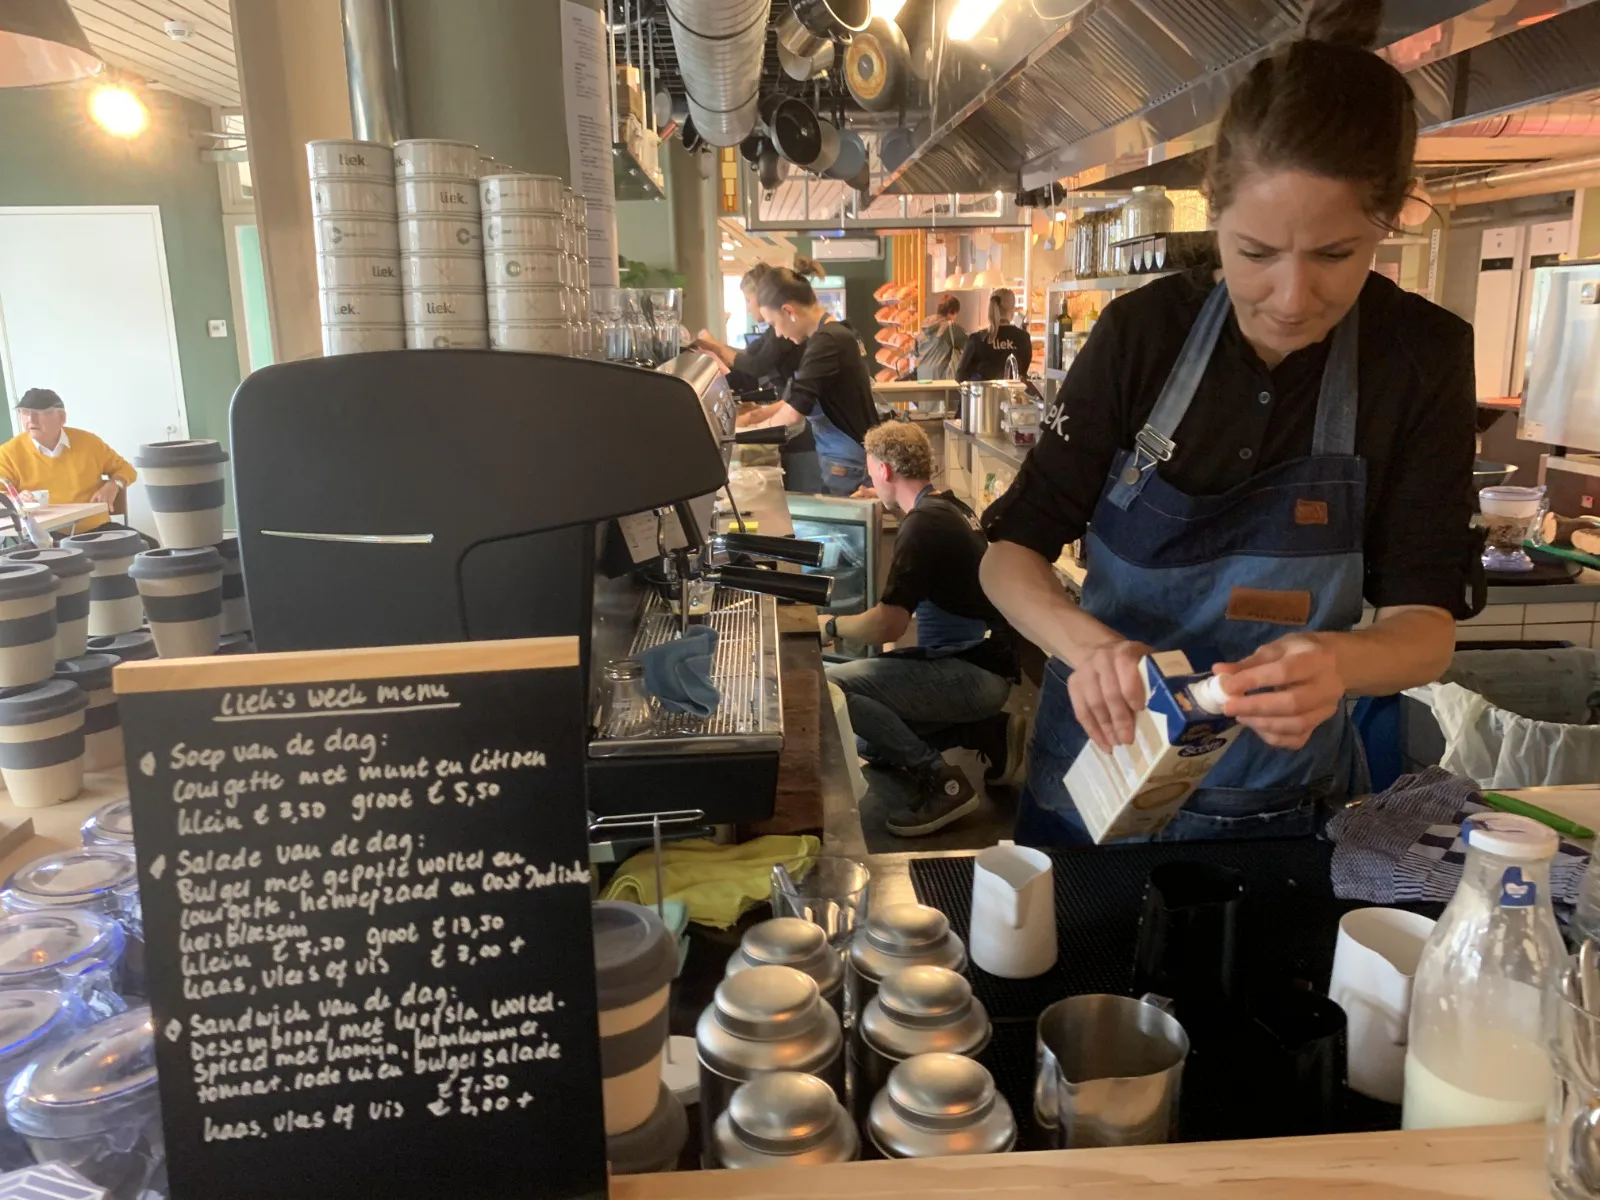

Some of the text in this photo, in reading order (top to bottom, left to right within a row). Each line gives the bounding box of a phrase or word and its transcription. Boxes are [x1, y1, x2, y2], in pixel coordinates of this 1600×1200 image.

[371, 265, 397, 278] liek.
[426, 302, 456, 314] liek.
[307, 683, 368, 708] week
[376, 683, 449, 704] menu
[170, 742, 226, 772] Soep
[232, 742, 279, 762] van
[286, 732, 315, 756] de
[299, 764, 348, 785] met
[358, 756, 429, 781] munt
[435, 758, 464, 777] en
[178, 808, 243, 836] klein
[351, 787, 413, 821] groot
[453, 781, 500, 807] 5,50
[176, 847, 262, 876] Salade
[276, 844, 322, 865] van
[331, 833, 360, 857] de
[264, 869, 314, 893] met
[417, 849, 484, 875] wortel
[181, 950, 252, 977] klein
[366, 922, 420, 956] groot
[325, 959, 348, 988] of
[355, 956, 390, 975] vis
[190, 1000, 311, 1037] Sandwich
[318, 998, 358, 1018] van
[363, 987, 392, 1012] de
[339, 1016, 385, 1041] met
[275, 1045, 319, 1066] met
[294, 1065, 341, 1090] rode
[377, 1062, 403, 1080] en
[482, 1040, 561, 1068] salade
[333, 1102, 355, 1130] of
[369, 1100, 405, 1120] vis
